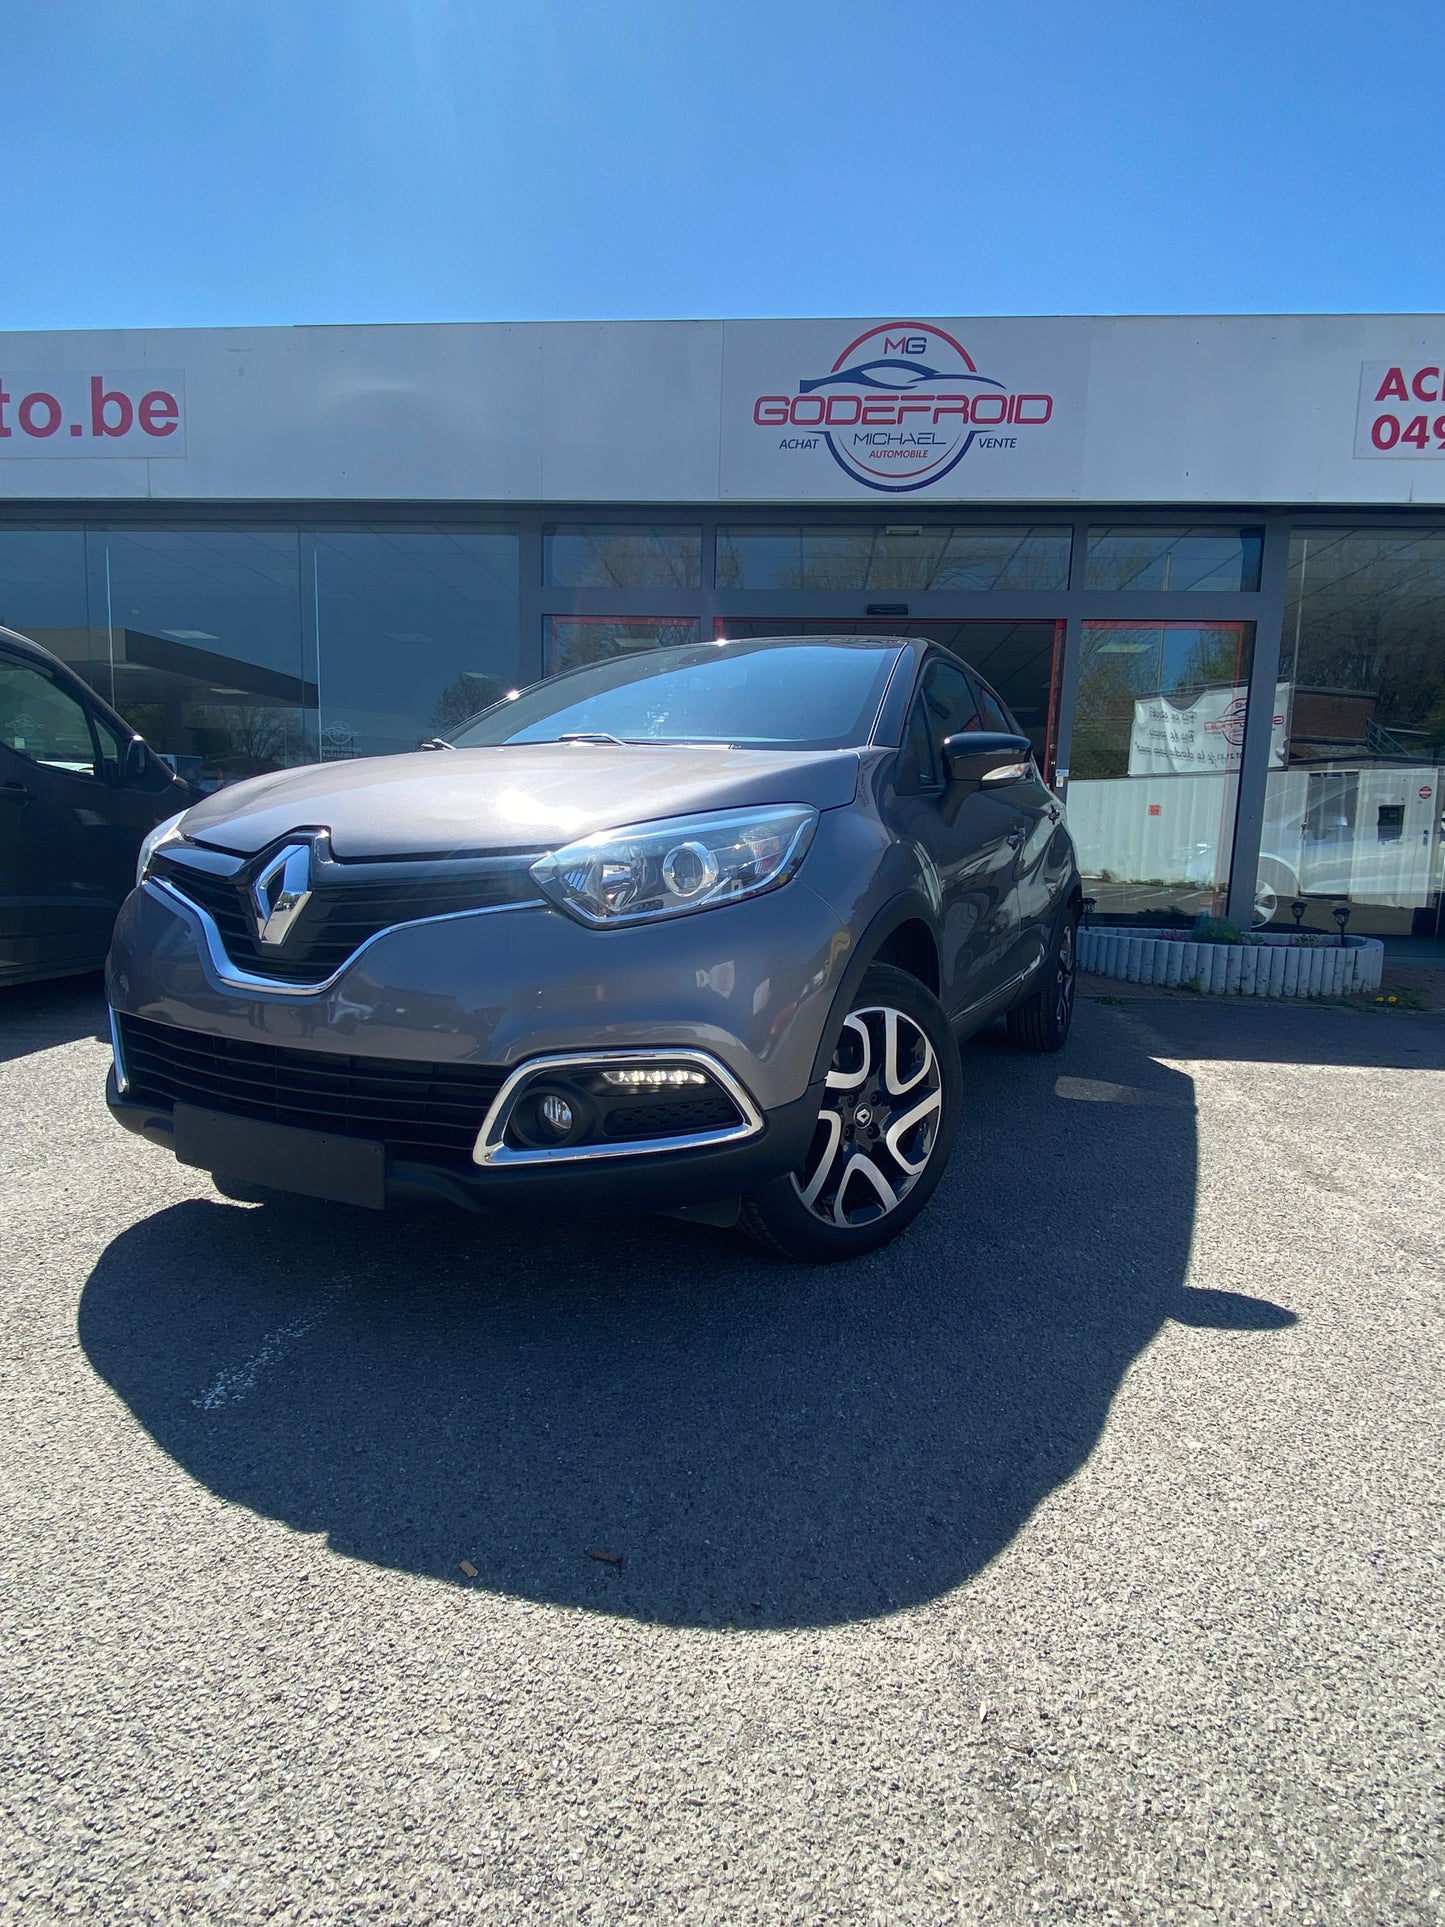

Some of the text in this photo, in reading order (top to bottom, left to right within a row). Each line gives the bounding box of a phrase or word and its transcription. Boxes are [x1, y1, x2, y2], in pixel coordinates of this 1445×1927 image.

[884, 336, 927, 355] MG
[753, 394, 1053, 425] GODEFROID
[779, 438, 820, 450] ACHAT
[853, 432, 947, 446] MICHAEL
[978, 437, 1018, 449] VENTE
[869, 449, 929, 459] AUTOMOBILE
